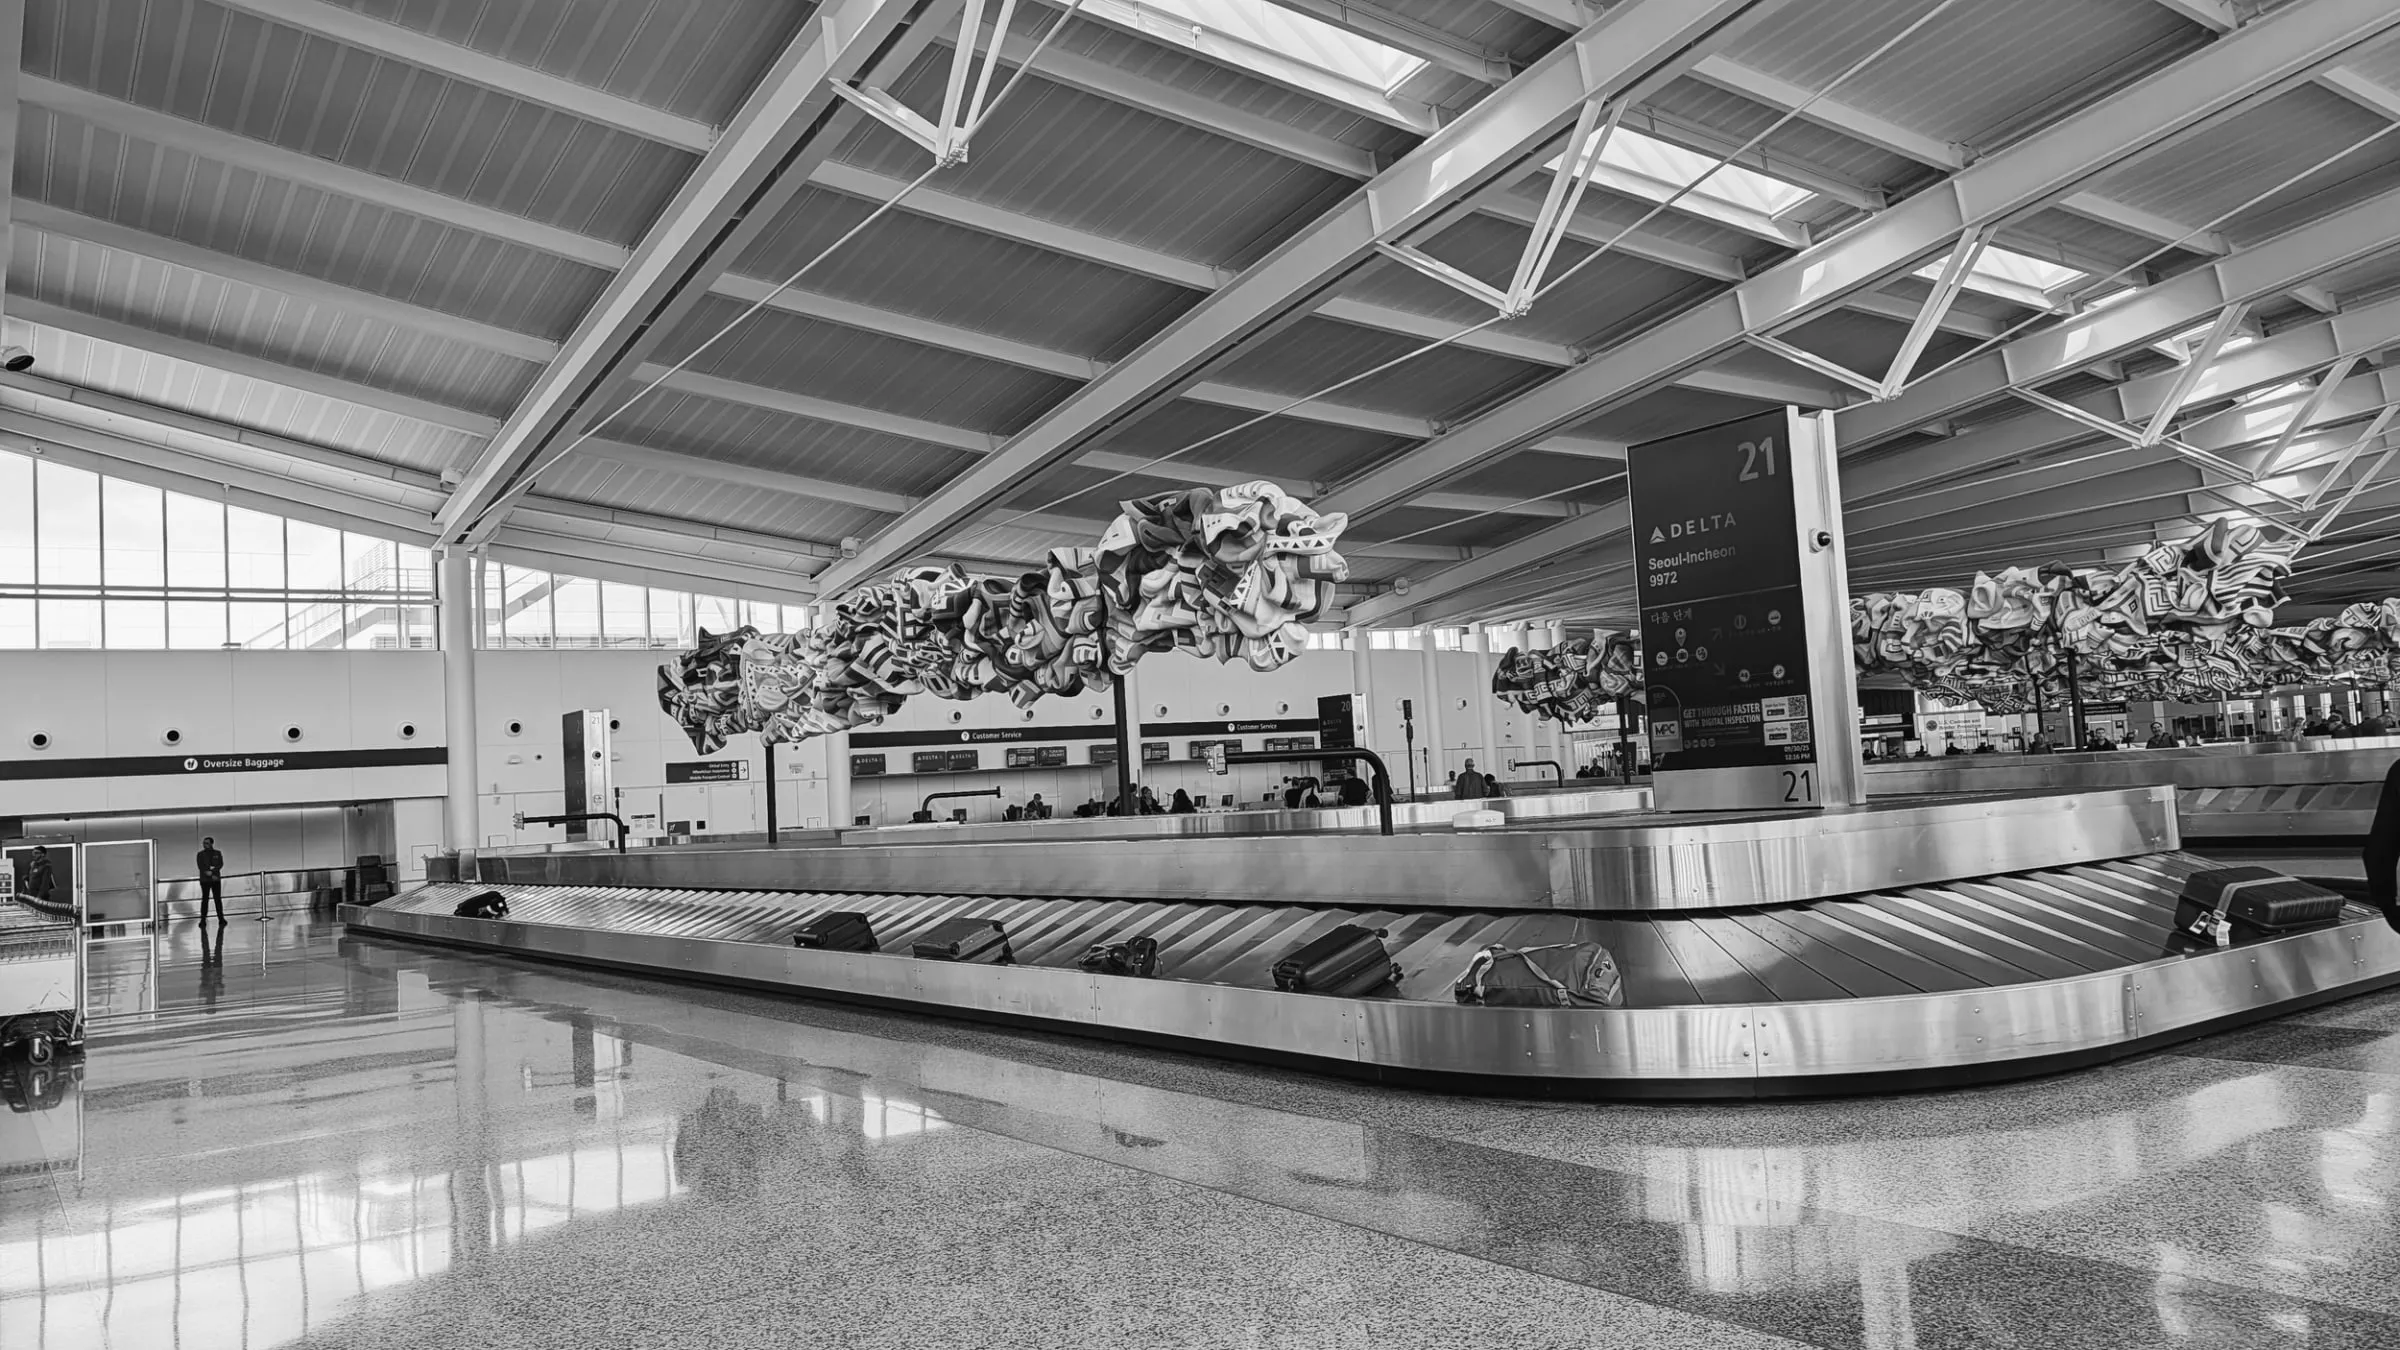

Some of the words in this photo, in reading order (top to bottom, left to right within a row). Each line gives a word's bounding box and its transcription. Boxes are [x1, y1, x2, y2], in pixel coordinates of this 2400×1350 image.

[1737, 436, 1775, 482] 21
[1670, 512, 1736, 538] DELTA
[1648, 545, 1736, 570] Seoul-Incheon
[1649, 571, 1678, 587] 9972
[1651, 611, 1670, 625] 다음
[1673, 607, 1692, 621] 단계
[1341, 700, 1351, 712] 20
[1683, 708, 1697, 718] GET
[1697, 704, 1731, 717] THROUGH
[1733, 702, 1760, 715] FASTER
[592, 716, 600, 725] 21
[1702, 717, 1724, 727] DIGITAL
[1725, 714, 1761, 725] INSPECTION
[972, 732, 1000, 740] Customer
[1655, 723, 1676, 737] MPC
[203, 759, 242, 768] Oversize
[245, 758, 284, 768] Baggage
[1783, 770, 1812, 802] 21
